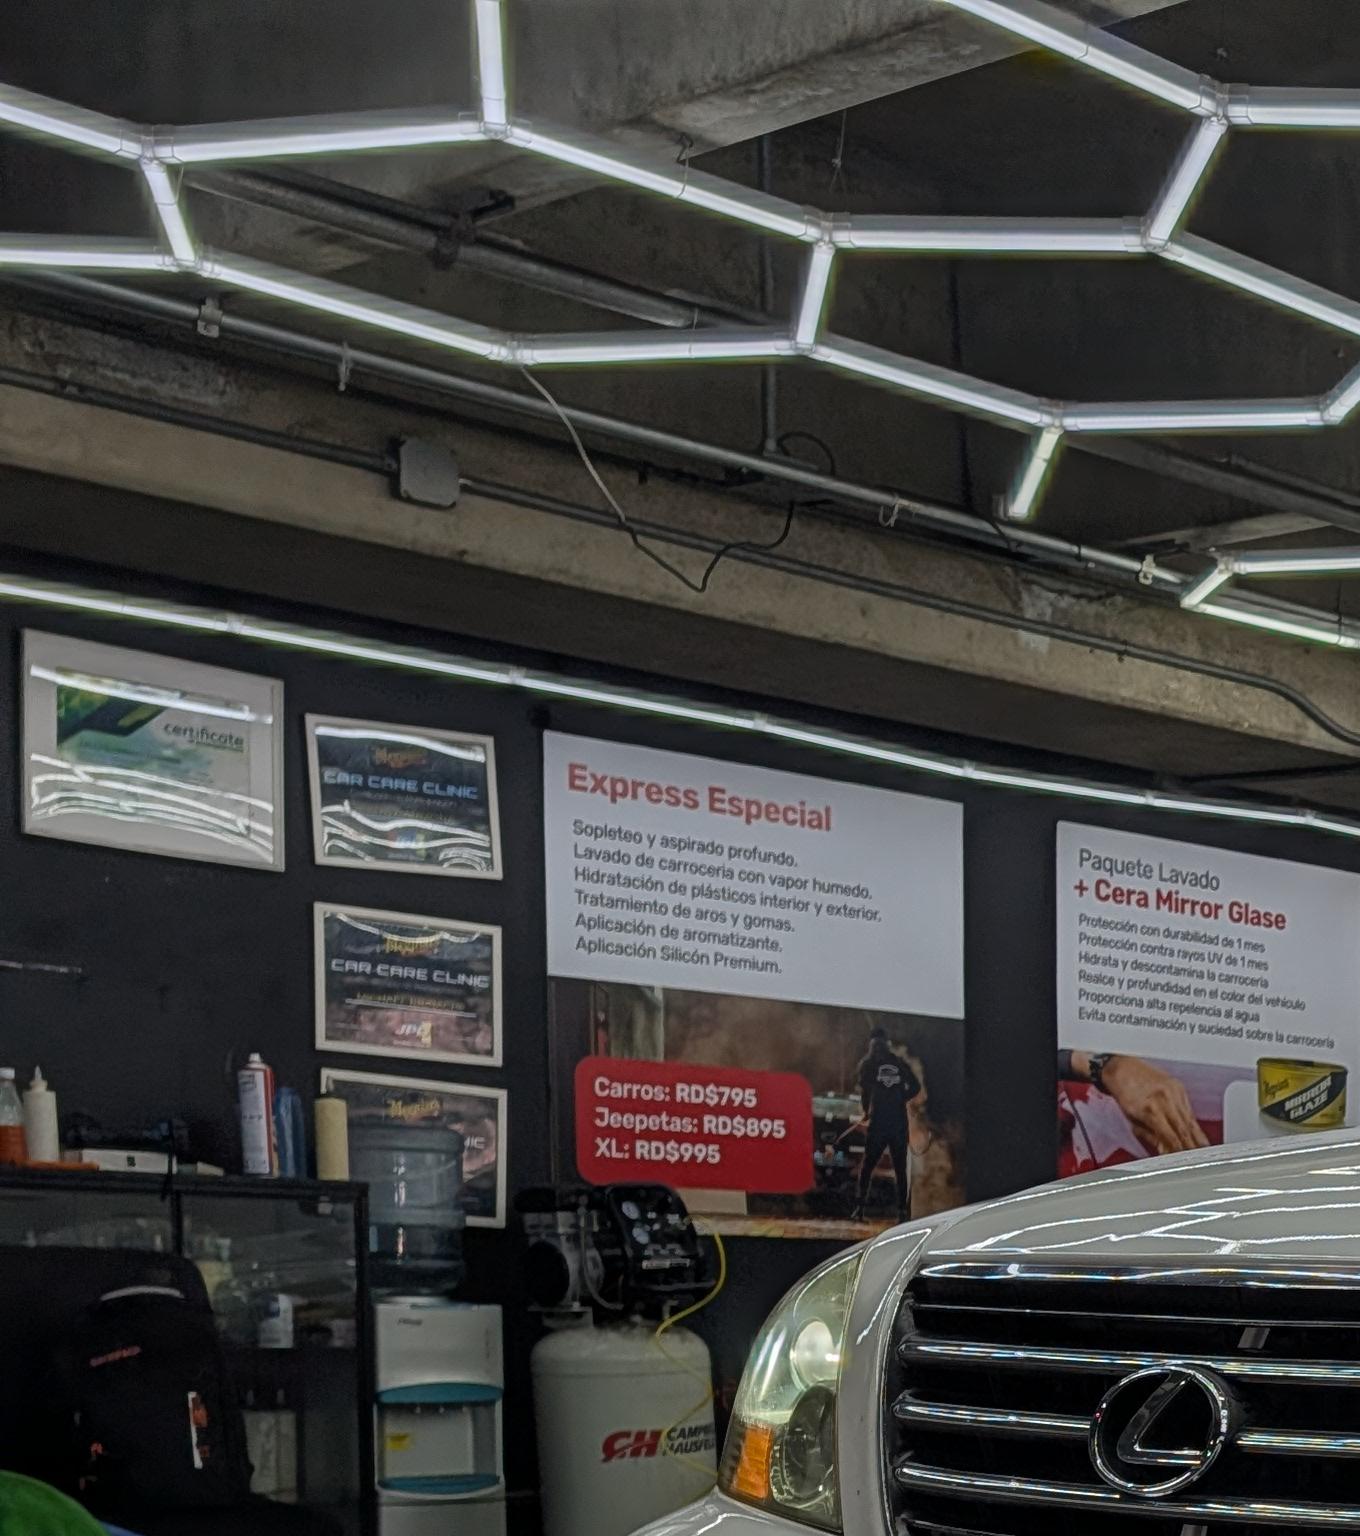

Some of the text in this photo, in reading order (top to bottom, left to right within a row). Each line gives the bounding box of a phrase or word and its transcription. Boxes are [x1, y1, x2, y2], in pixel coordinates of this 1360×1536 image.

[164, 722, 245, 746] certificate
[323, 770, 364, 787] CAR
[367, 776, 419, 793] CARE
[422, 781, 479, 800] CLINIC
[568, 763, 831, 831] Express Especial
[573, 819, 797, 867] Sopleteo y aspirado profundo.
[574, 843, 631, 865] Lavado
[635, 853, 654, 868] de
[738, 870, 765, 884] con
[768, 874, 808, 890] vapor
[1079, 848, 1220, 891] Paquete Lavado
[575, 866, 881, 922] Hidratación de plásticos interior y exterior.
[575, 889, 795, 932] Tratamiento de aros y gomas.
[1095, 879, 1149, 908] Cera
[1156, 889, 1223, 919] Mirror
[1229, 901, 1286, 930] Glase
[575, 913, 782, 952] Aplicación de aromatizante.
[1079, 913, 1265, 953] Protección con durabilidad de 1 mes
[576, 936, 782, 973] Aplicación Silicón Premium.
[1079, 932, 1268, 971] Protección contra rayos UV de 1 mes
[1079, 951, 1119, 968] Hidrata
[1121, 960, 1128, 972] y
[1131, 959, 1204, 980] descontamina
[1207, 969, 1216, 981] la
[331, 958, 372, 975] CAR
[376, 963, 428, 981] CARE
[432, 970, 491, 989] CLINIC
[1079, 969, 1115, 987] Realce
[1118, 978, 1124, 989] y
[1127, 978, 1191, 996] profundidad
[1193, 988, 1207, 998] en
[1209, 988, 1218, 999] el
[1220, 991, 1245, 1002] color
[1248, 993, 1263, 1005] del
[1079, 988, 1144, 1008] Proporciona
[1146, 998, 1166, 1011] alta
[1224, 1008, 1233, 1019] al
[1235, 1010, 1260, 1024] agua
[1079, 1007, 1106, 1022] Evita
[1109, 1013, 1187, 1031] contaminación
[1189, 1023, 1195, 1034] y
[1198, 1024, 1243, 1038] suciedad
[1246, 1029, 1273, 1041] sobre
[1276, 1031, 1284, 1043] la
[595, 1077, 757, 1107] Carros: RD$795
[1289, 1092, 1329, 1123] GLAZE
[703, 1115, 785, 1138] RD$895
[595, 1137, 720, 1163] XL: RD$995
